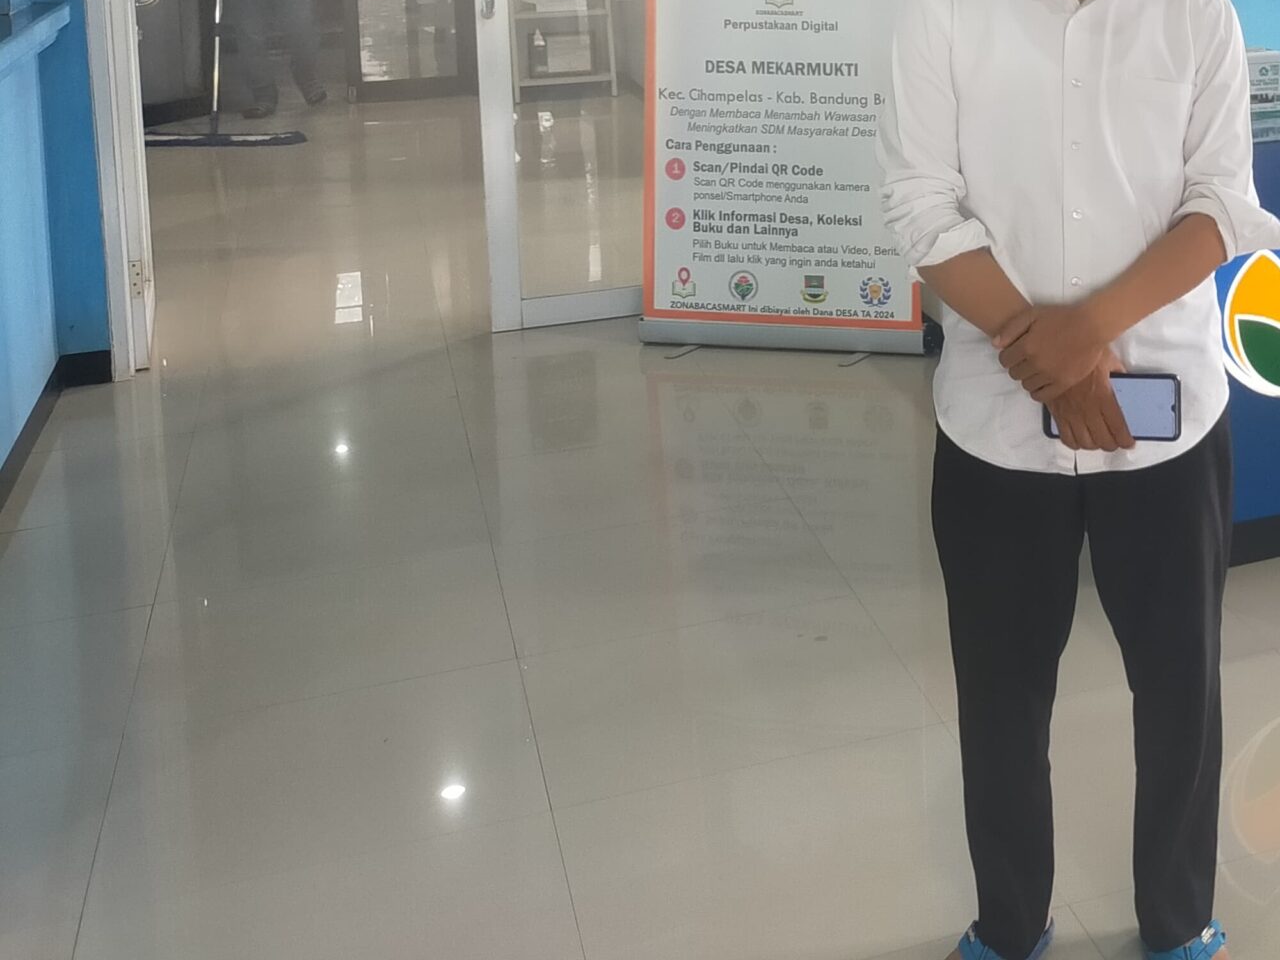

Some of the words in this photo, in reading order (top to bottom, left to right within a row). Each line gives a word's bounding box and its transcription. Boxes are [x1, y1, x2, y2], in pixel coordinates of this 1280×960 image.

[723, 19, 798, 32] Perpustakaan
[801, 20, 839, 33] Digital
[705, 60, 747, 74] DESA
[751, 61, 859, 77] MEKARMUKTI
[658, 87, 685, 100] Kec.
[688, 88, 763, 104] Cihampelas
[776, 90, 805, 104] Kab.
[809, 91, 868, 109] Bandung
[670, 106, 707, 119] Dengan
[709, 107, 761, 119] Membaca
[763, 109, 821, 121] Menambah
[824, 110, 877, 122] Wawasan
[687, 121, 758, 135] Meningkatkan
[760, 123, 785, 135] SDM
[786, 125, 849, 138] Masyarakat
[665, 138, 692, 151] Cara
[695, 140, 770, 155] Penggunaan
[671, 161, 680, 174] 1
[693, 160, 769, 176] Scan/Pindai
[771, 163, 789, 177] QR
[791, 164, 824, 176] Code
[694, 177, 717, 187] Scan
[718, 178, 735, 188] QR
[738, 178, 763, 188] Code
[765, 181, 831, 192] menggunakan
[834, 182, 870, 192] kamera
[693, 191, 782, 203] ponsel/Smartphone
[784, 193, 809, 204] Anda
[671, 212, 680, 224] 2
[693, 209, 716, 221] Klik
[718, 210, 776, 223] Informasi
[779, 212, 813, 227] Desa,
[816, 213, 862, 226] Koleksi
[693, 221, 723, 233] Buku
[726, 223, 750, 235] dan
[753, 224, 798, 239] Lainnya
[692, 239, 712, 249] Pilih
[714, 240, 739, 250] Buku
[741, 241, 767, 251] untuk
[769, 242, 815, 254] Membaca
[817, 244, 839, 254] atau
[840, 245, 871, 256] Video,
[692, 252, 712, 262] Film
[713, 253, 725, 263] dll
[727, 254, 744, 264] lalu
[747, 255, 762, 264] klik
[765, 257, 787, 267] yang
[788, 257, 812, 269] ingin
[814, 258, 839, 268] anda
[841, 259, 876, 269] ketahui
[670, 300, 747, 312] ZONABACASMART
[760, 305, 791, 316] dibiayai
[792, 307, 810, 315] oleh
[812, 308, 834, 316] Dana
[835, 309, 859, 318] DESA
[861, 310, 871, 318] TA
[873, 310, 895, 319] 2024
